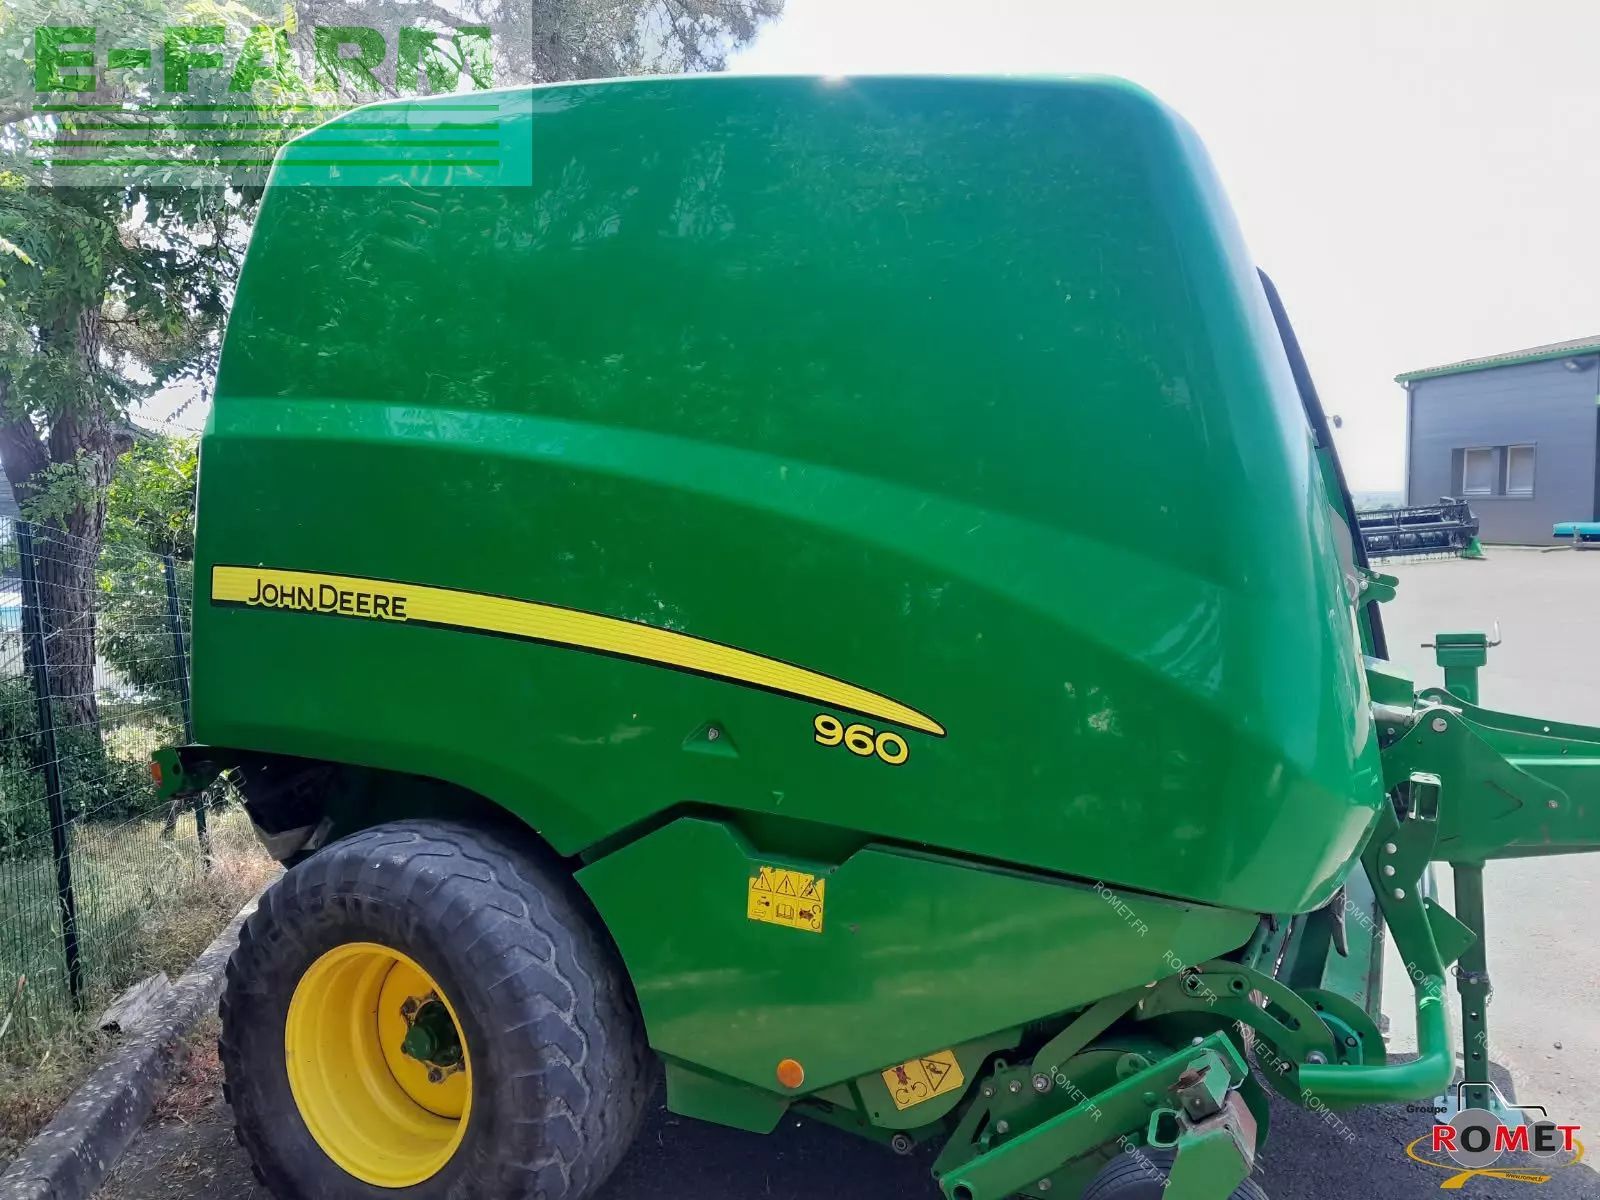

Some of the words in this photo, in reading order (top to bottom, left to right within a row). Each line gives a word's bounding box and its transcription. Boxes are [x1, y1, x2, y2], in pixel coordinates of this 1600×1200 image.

[248, 578, 313, 608] JOHN
[318, 583, 407, 618] DEERE
[813, 713, 909, 766] 960
